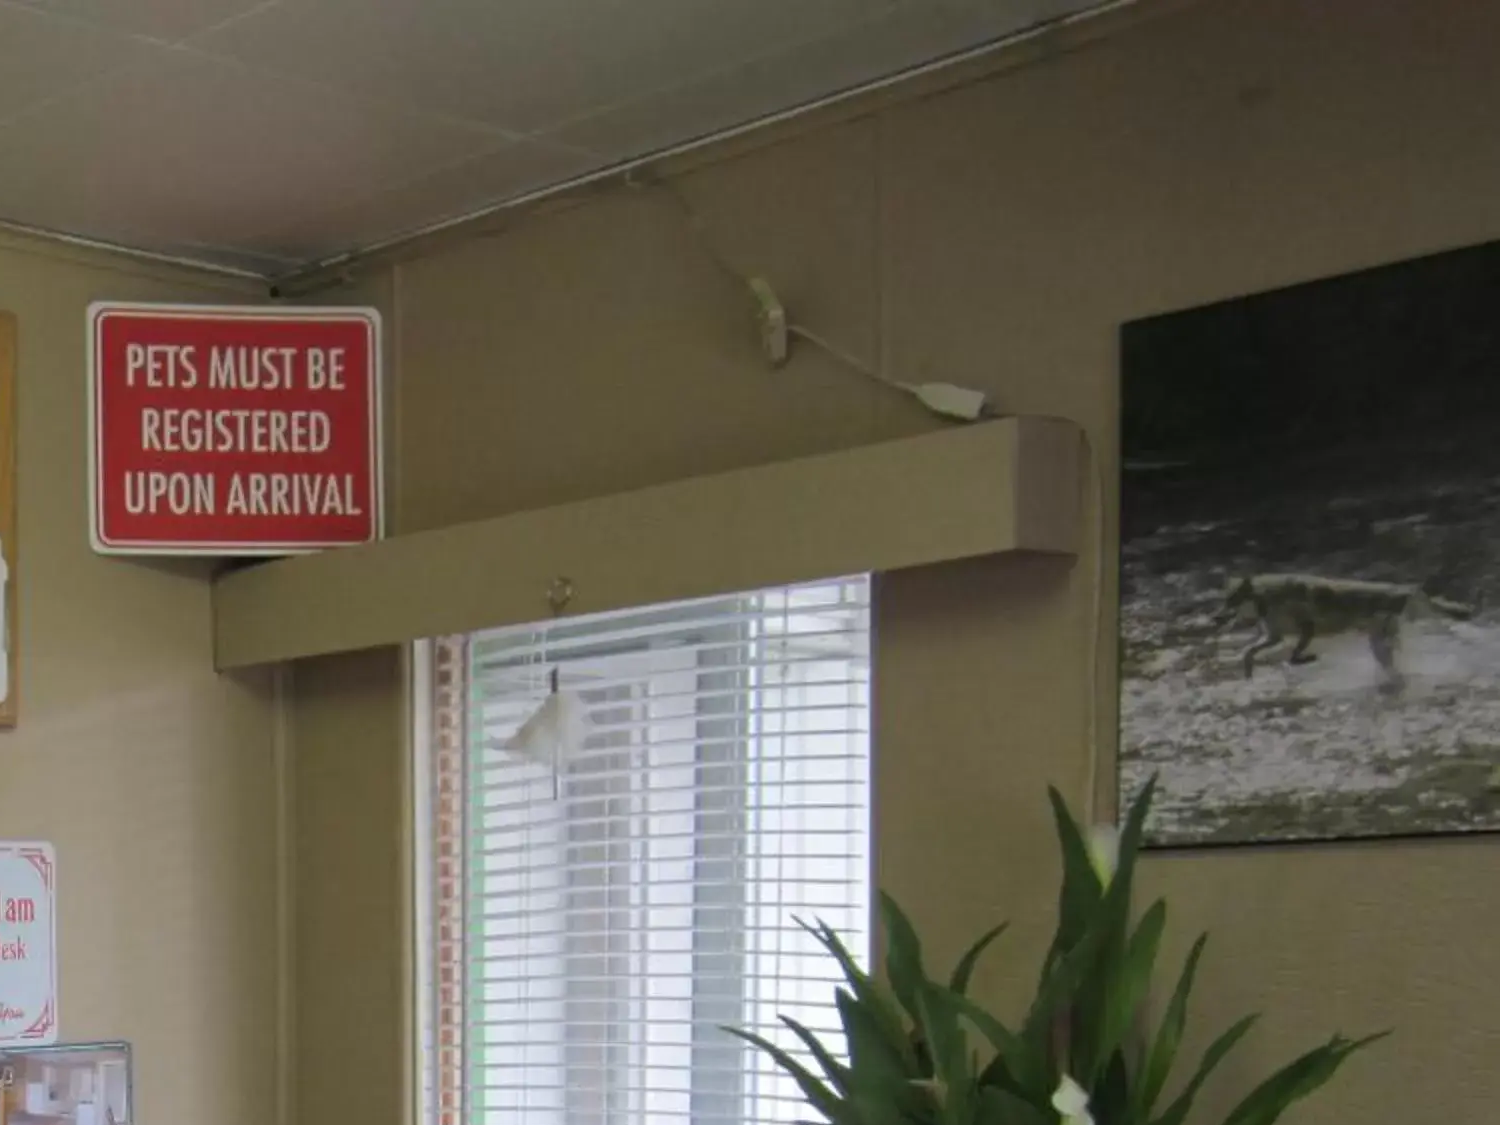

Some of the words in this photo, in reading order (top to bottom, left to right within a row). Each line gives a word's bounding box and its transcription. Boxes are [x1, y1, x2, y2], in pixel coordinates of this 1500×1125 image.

[125, 343, 197, 388] PETS
[209, 345, 297, 390] MUST
[307, 347, 345, 390] BE
[141, 408, 331, 453] REGISTERED
[124, 471, 215, 515] UPON
[226, 473, 362, 516] ARRIVAL
